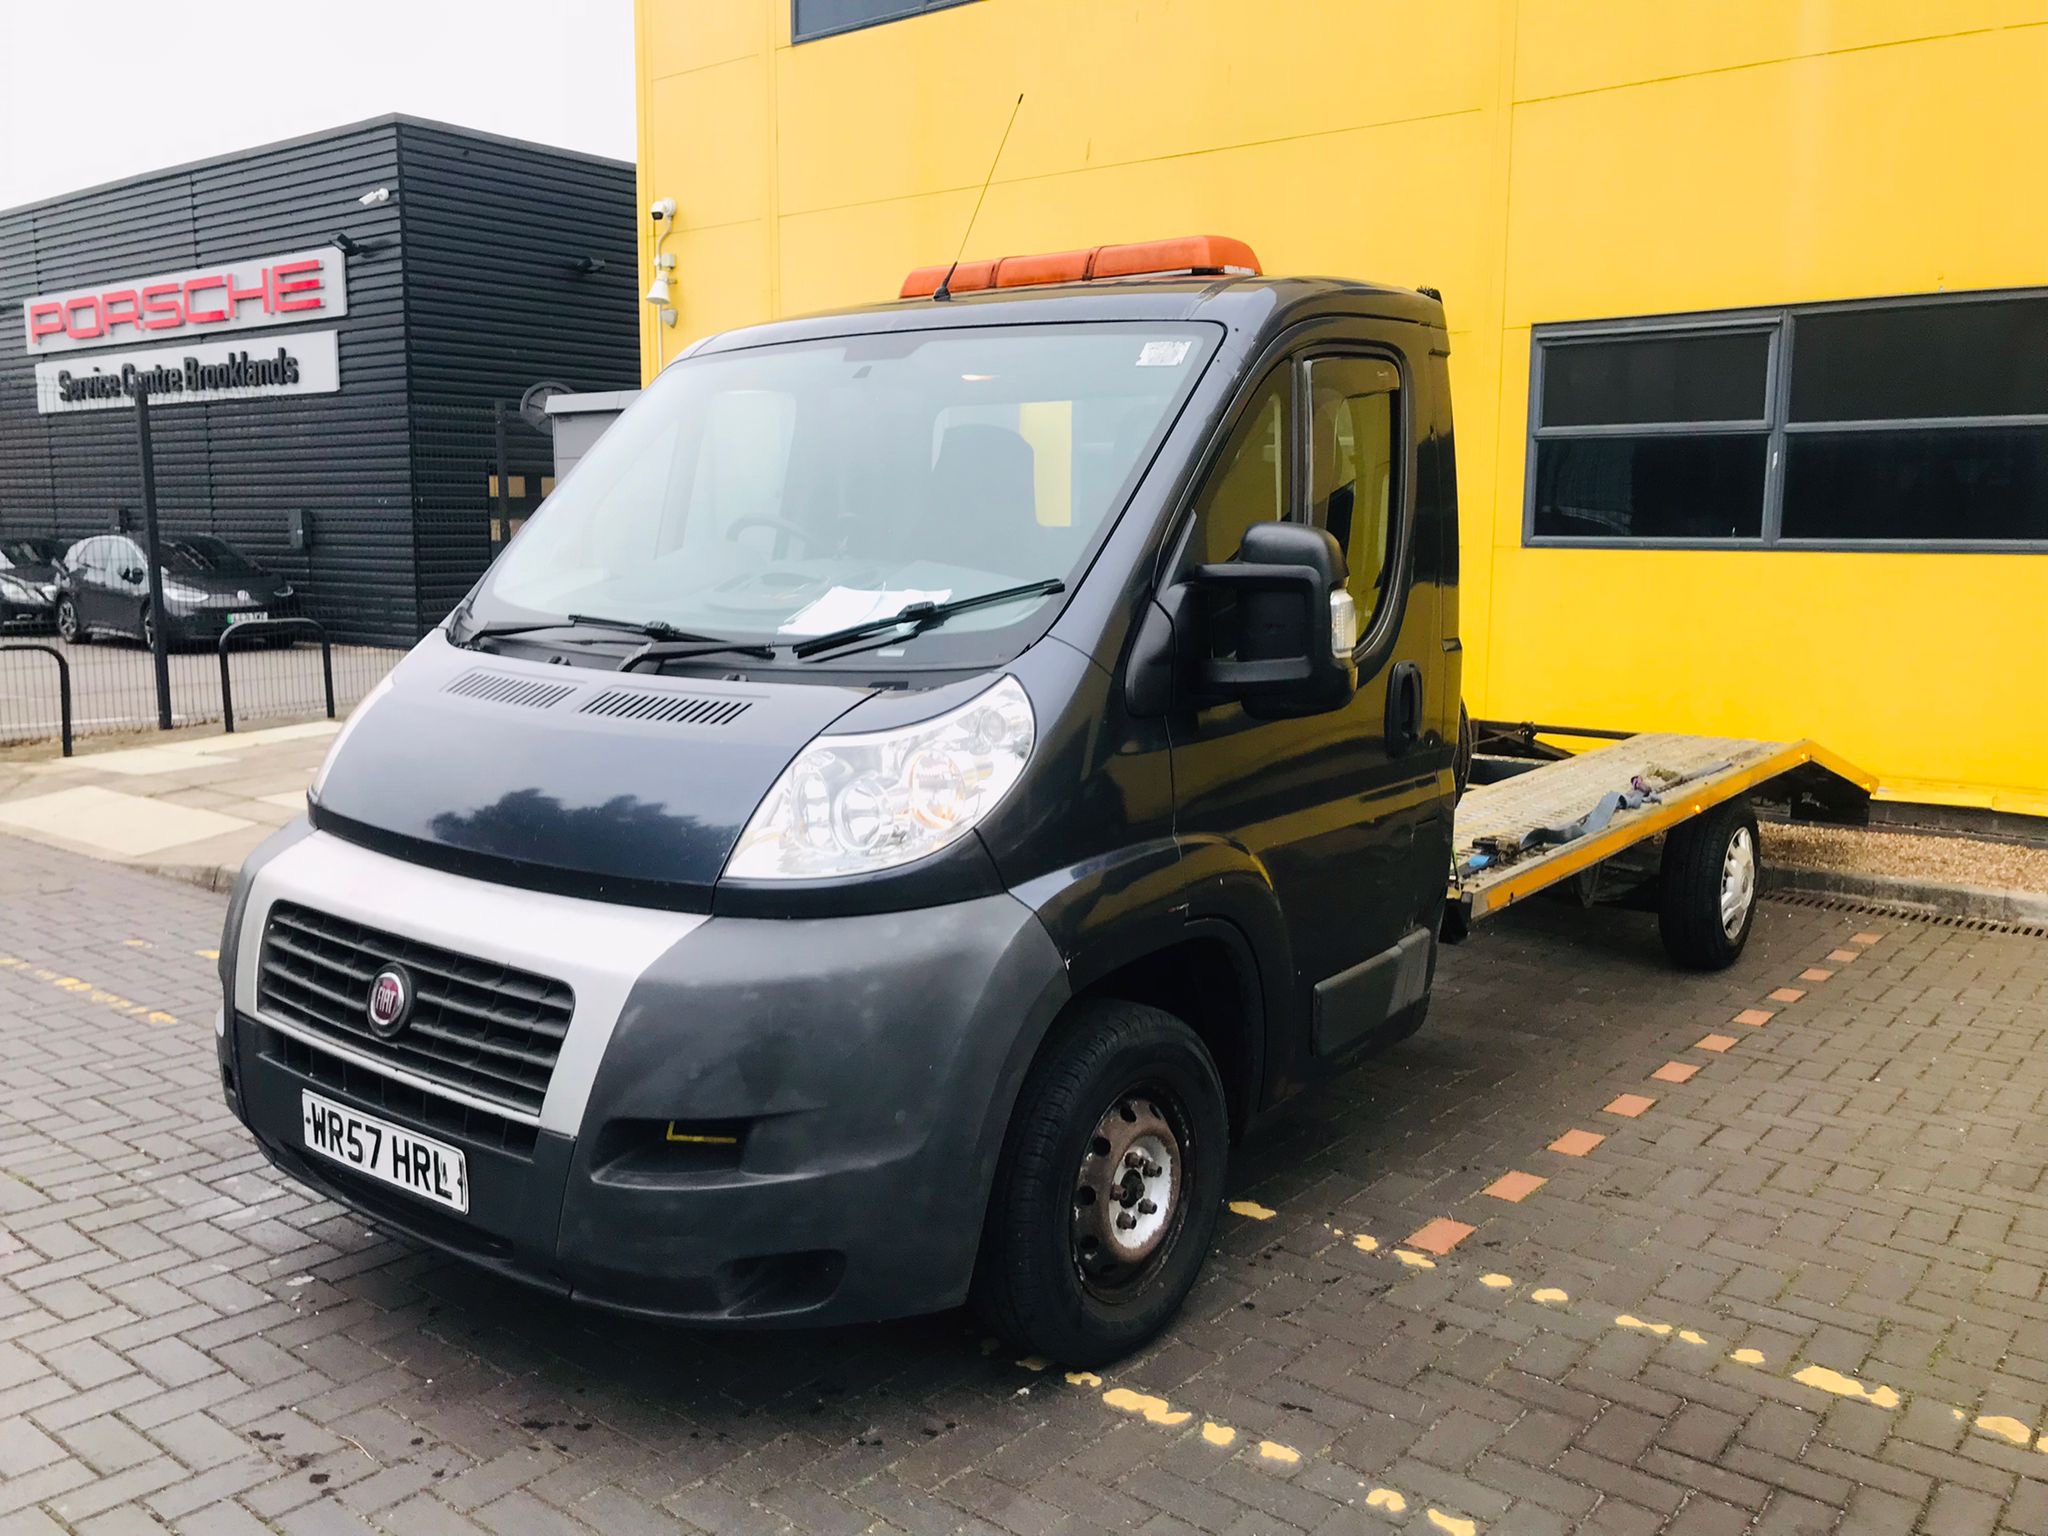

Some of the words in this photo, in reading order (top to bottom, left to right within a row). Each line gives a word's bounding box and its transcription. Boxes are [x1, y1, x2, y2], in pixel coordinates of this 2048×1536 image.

[30, 259, 325, 343] PORSCHE
[58, 367, 121, 401] Service
[121, 362, 183, 397] Centre
[184, 347, 299, 391] Brooklands
[376, 986, 397, 1013] FIAT
[311, 1102, 382, 1169] WR57
[392, 1135, 453, 1201] HRL
